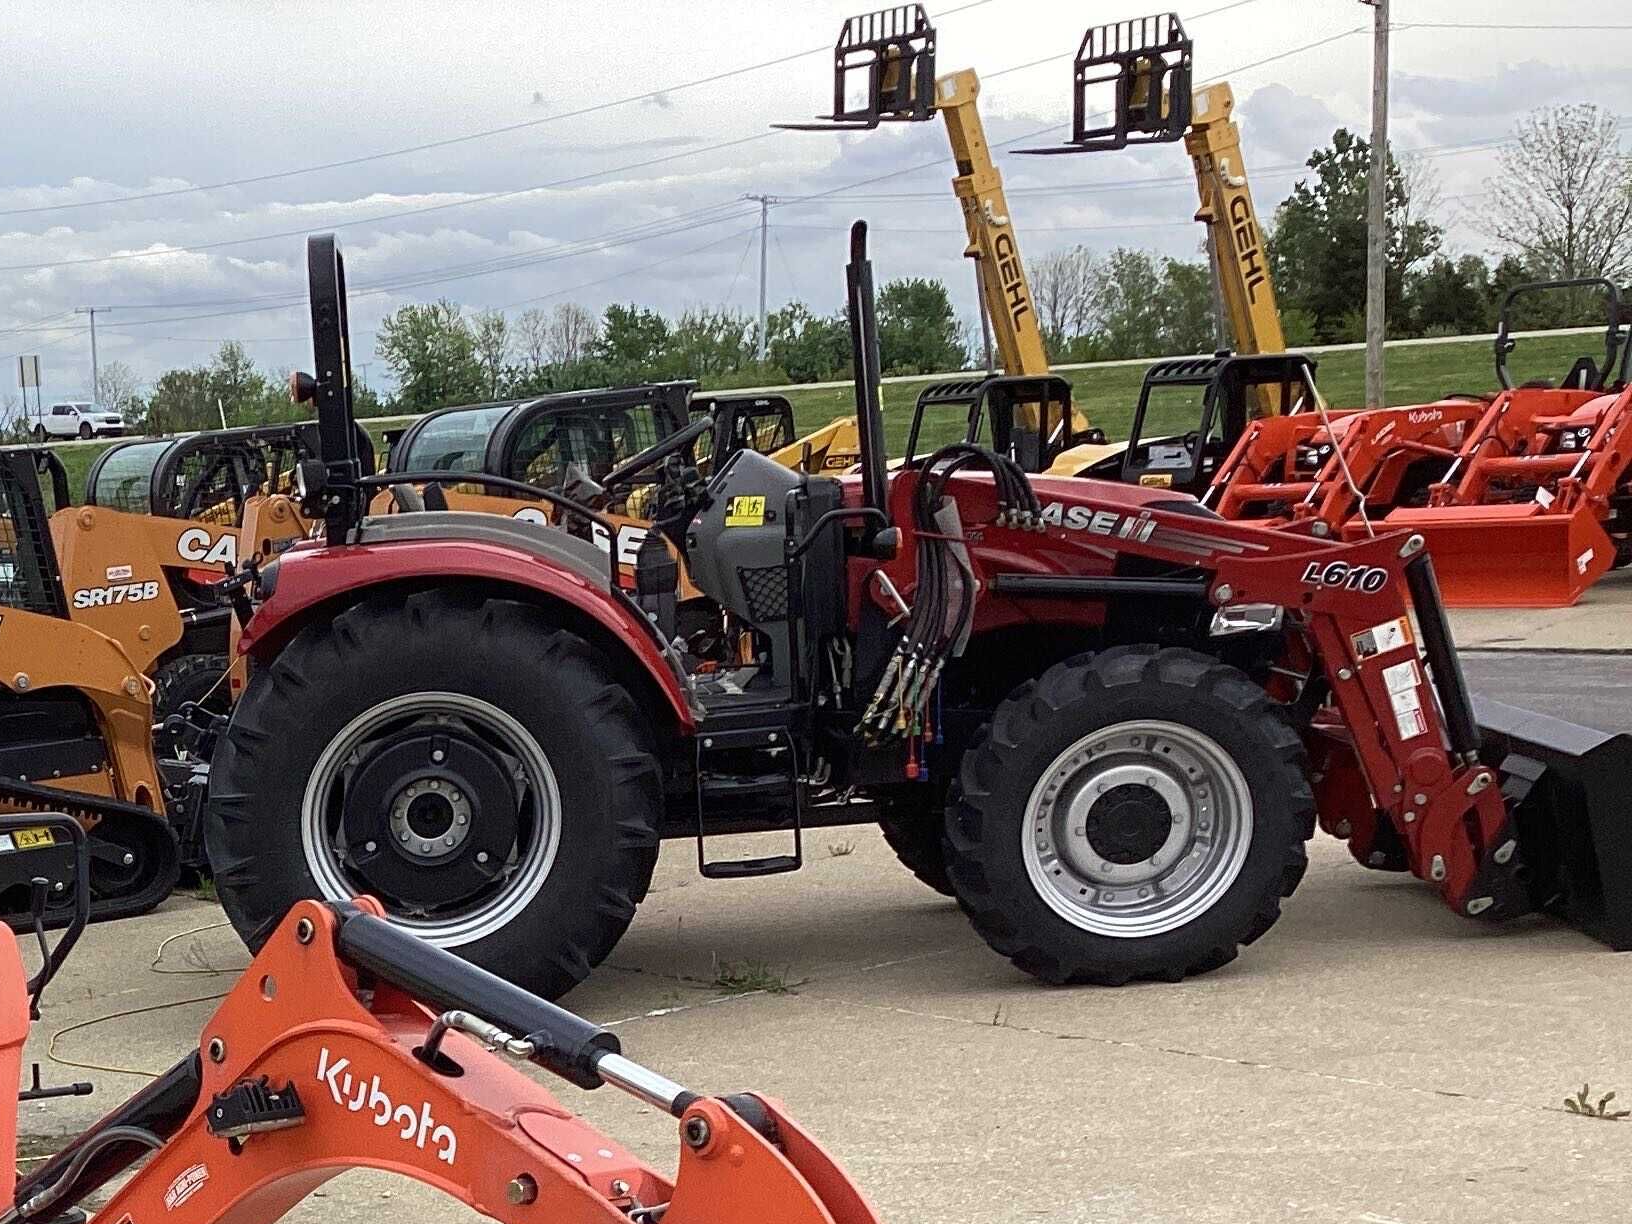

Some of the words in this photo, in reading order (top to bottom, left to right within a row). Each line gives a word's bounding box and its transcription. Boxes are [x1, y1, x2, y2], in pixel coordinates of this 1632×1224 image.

[1230, 195, 1265, 305] GEHL
[995, 233, 1028, 332] GEHL
[1408, 408, 1443, 423] Kubota
[1040, 501, 1119, 536] ASE
[73, 581, 159, 609] SR175B
[1300, 561, 1388, 594] L610
[317, 1047, 457, 1165] Kubota
